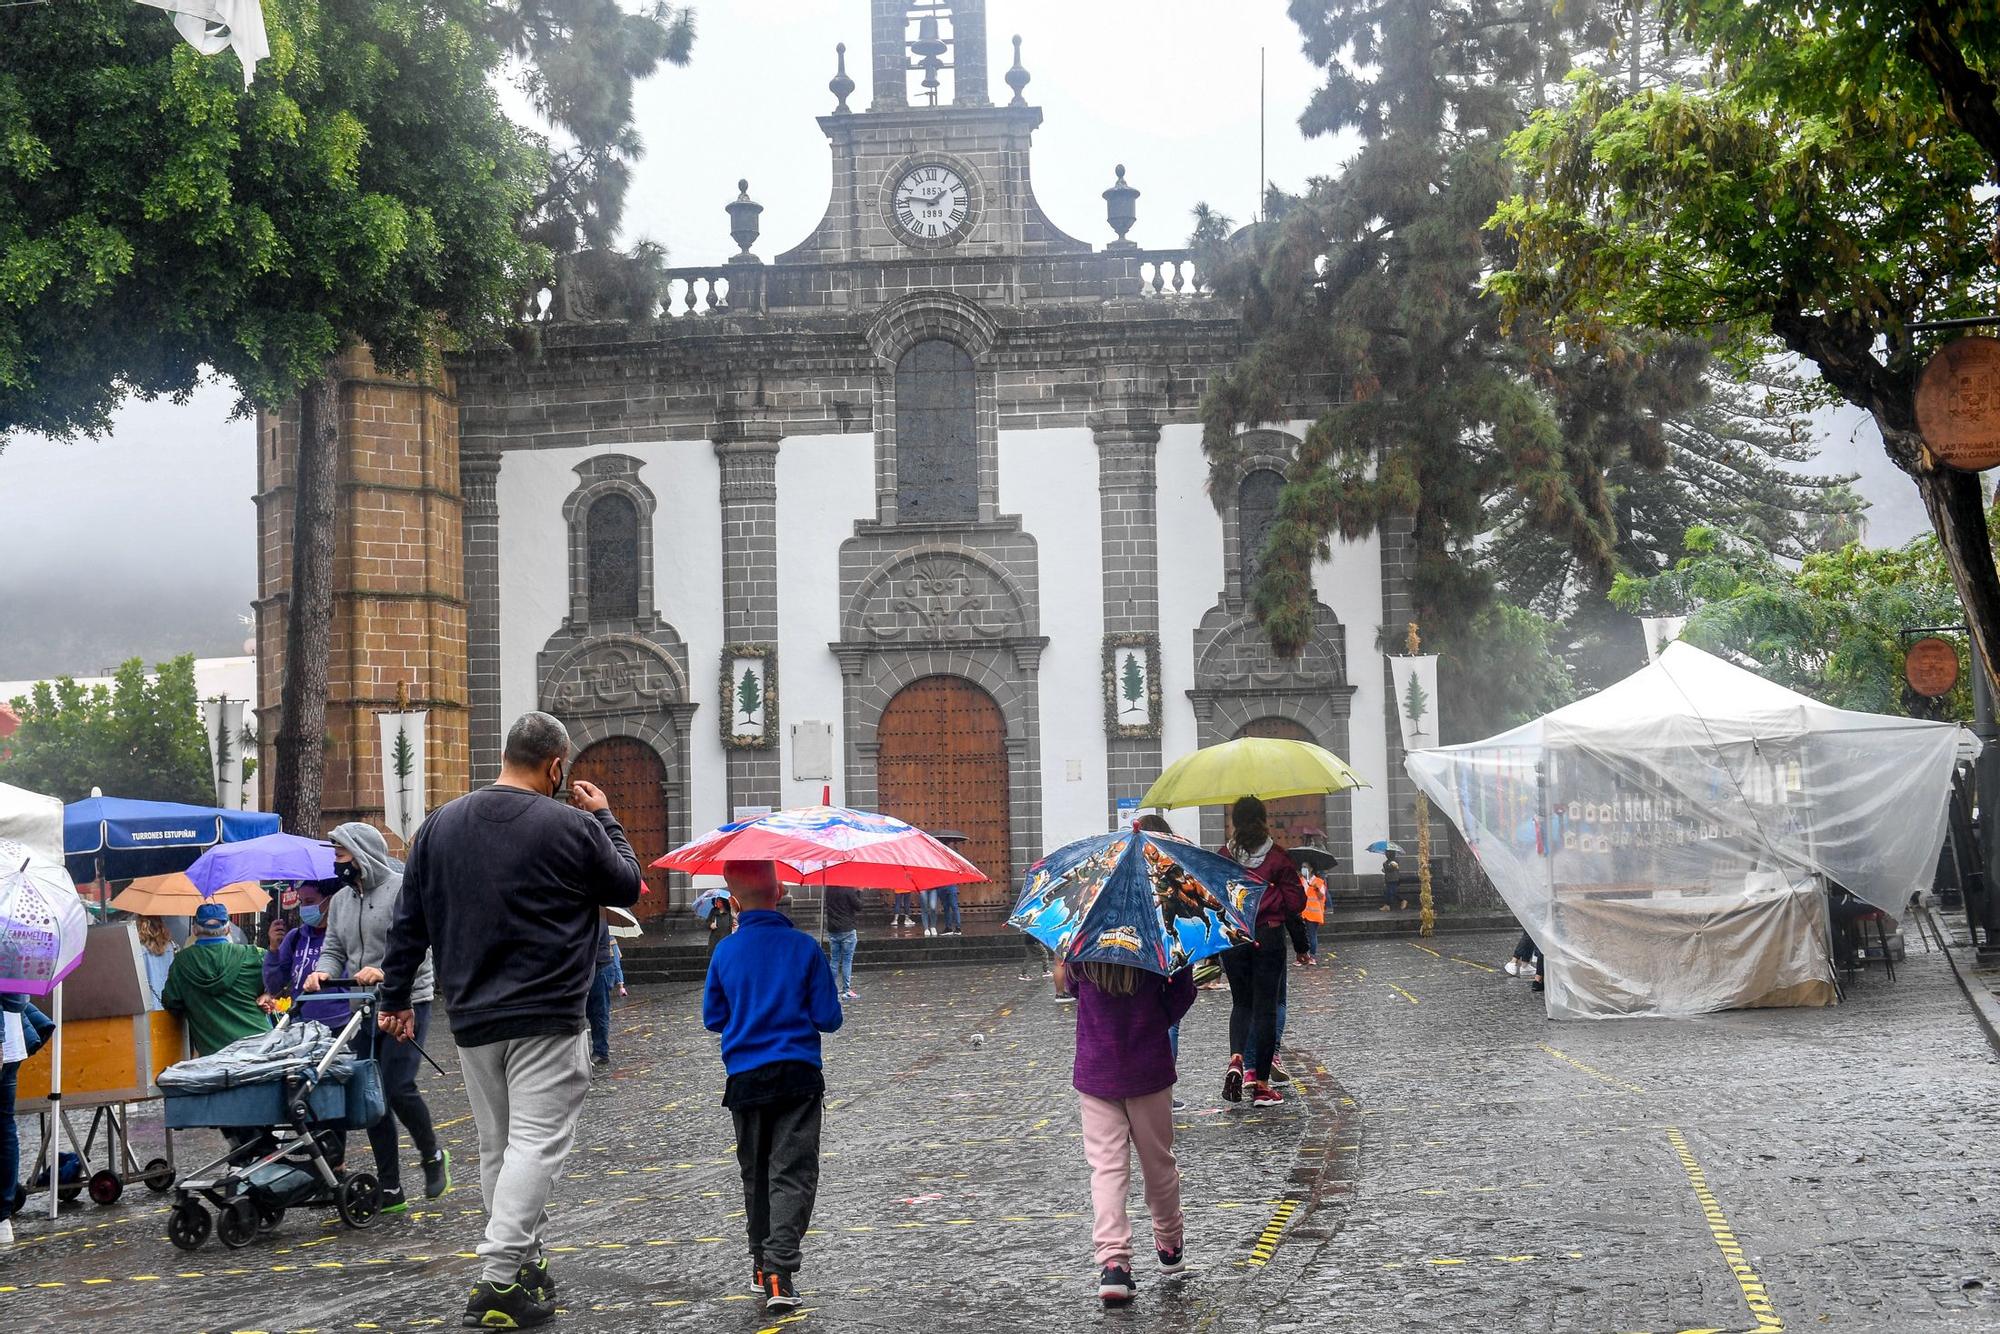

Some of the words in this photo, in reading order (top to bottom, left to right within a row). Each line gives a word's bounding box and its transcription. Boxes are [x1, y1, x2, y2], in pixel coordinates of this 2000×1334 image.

[925, 169, 937, 181] XII
[953, 197, 966, 206] III
[1939, 443, 1956, 451] LAS
[132, 831, 163, 841] TURRONES
[164, 829, 197, 839] ESTUPIÑAN
